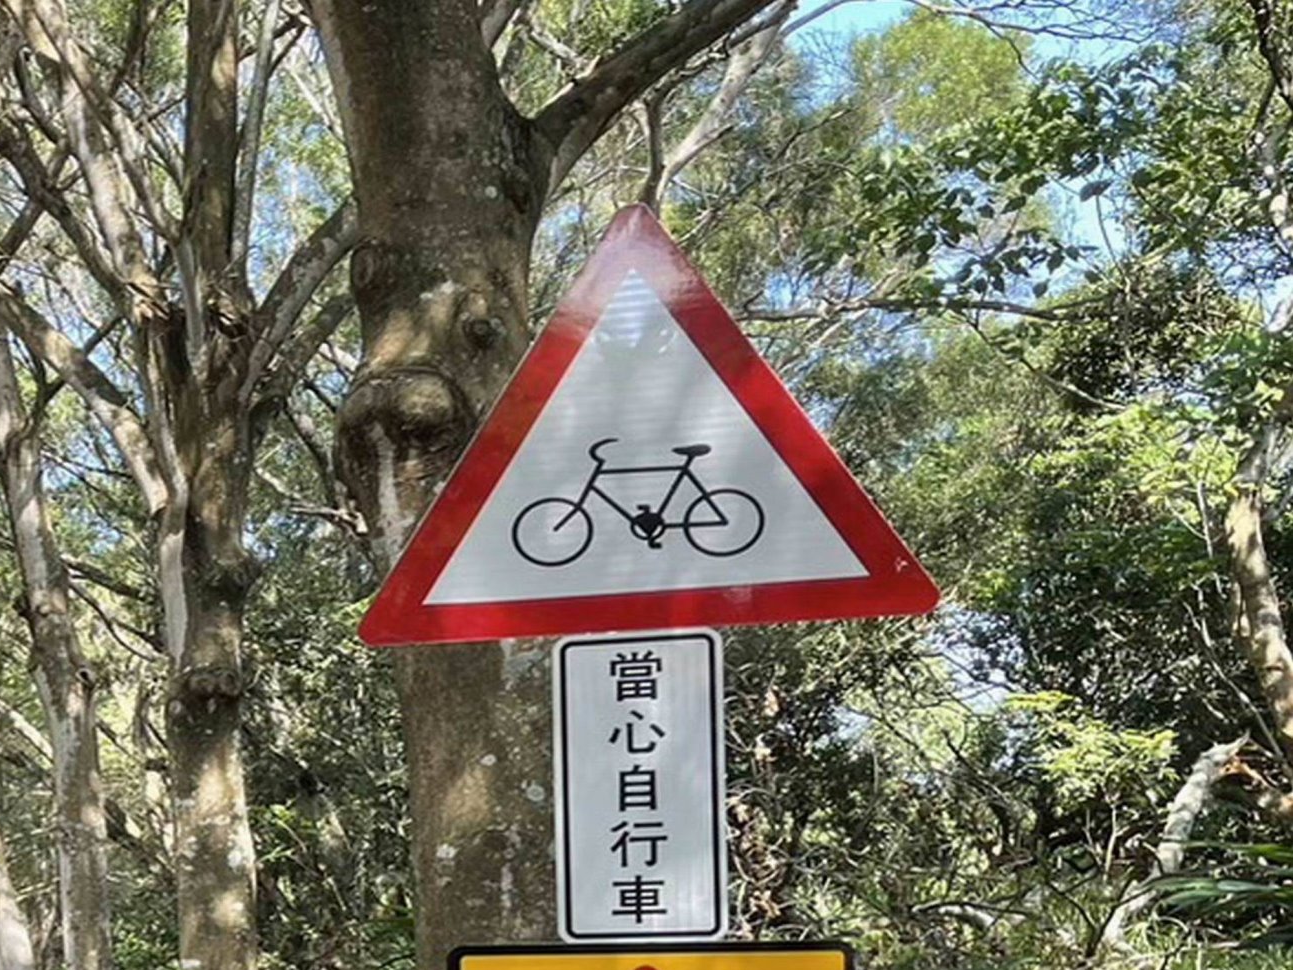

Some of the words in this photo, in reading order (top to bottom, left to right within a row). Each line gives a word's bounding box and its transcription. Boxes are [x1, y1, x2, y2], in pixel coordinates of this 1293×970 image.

[609, 650, 668, 924] 當心自行車
